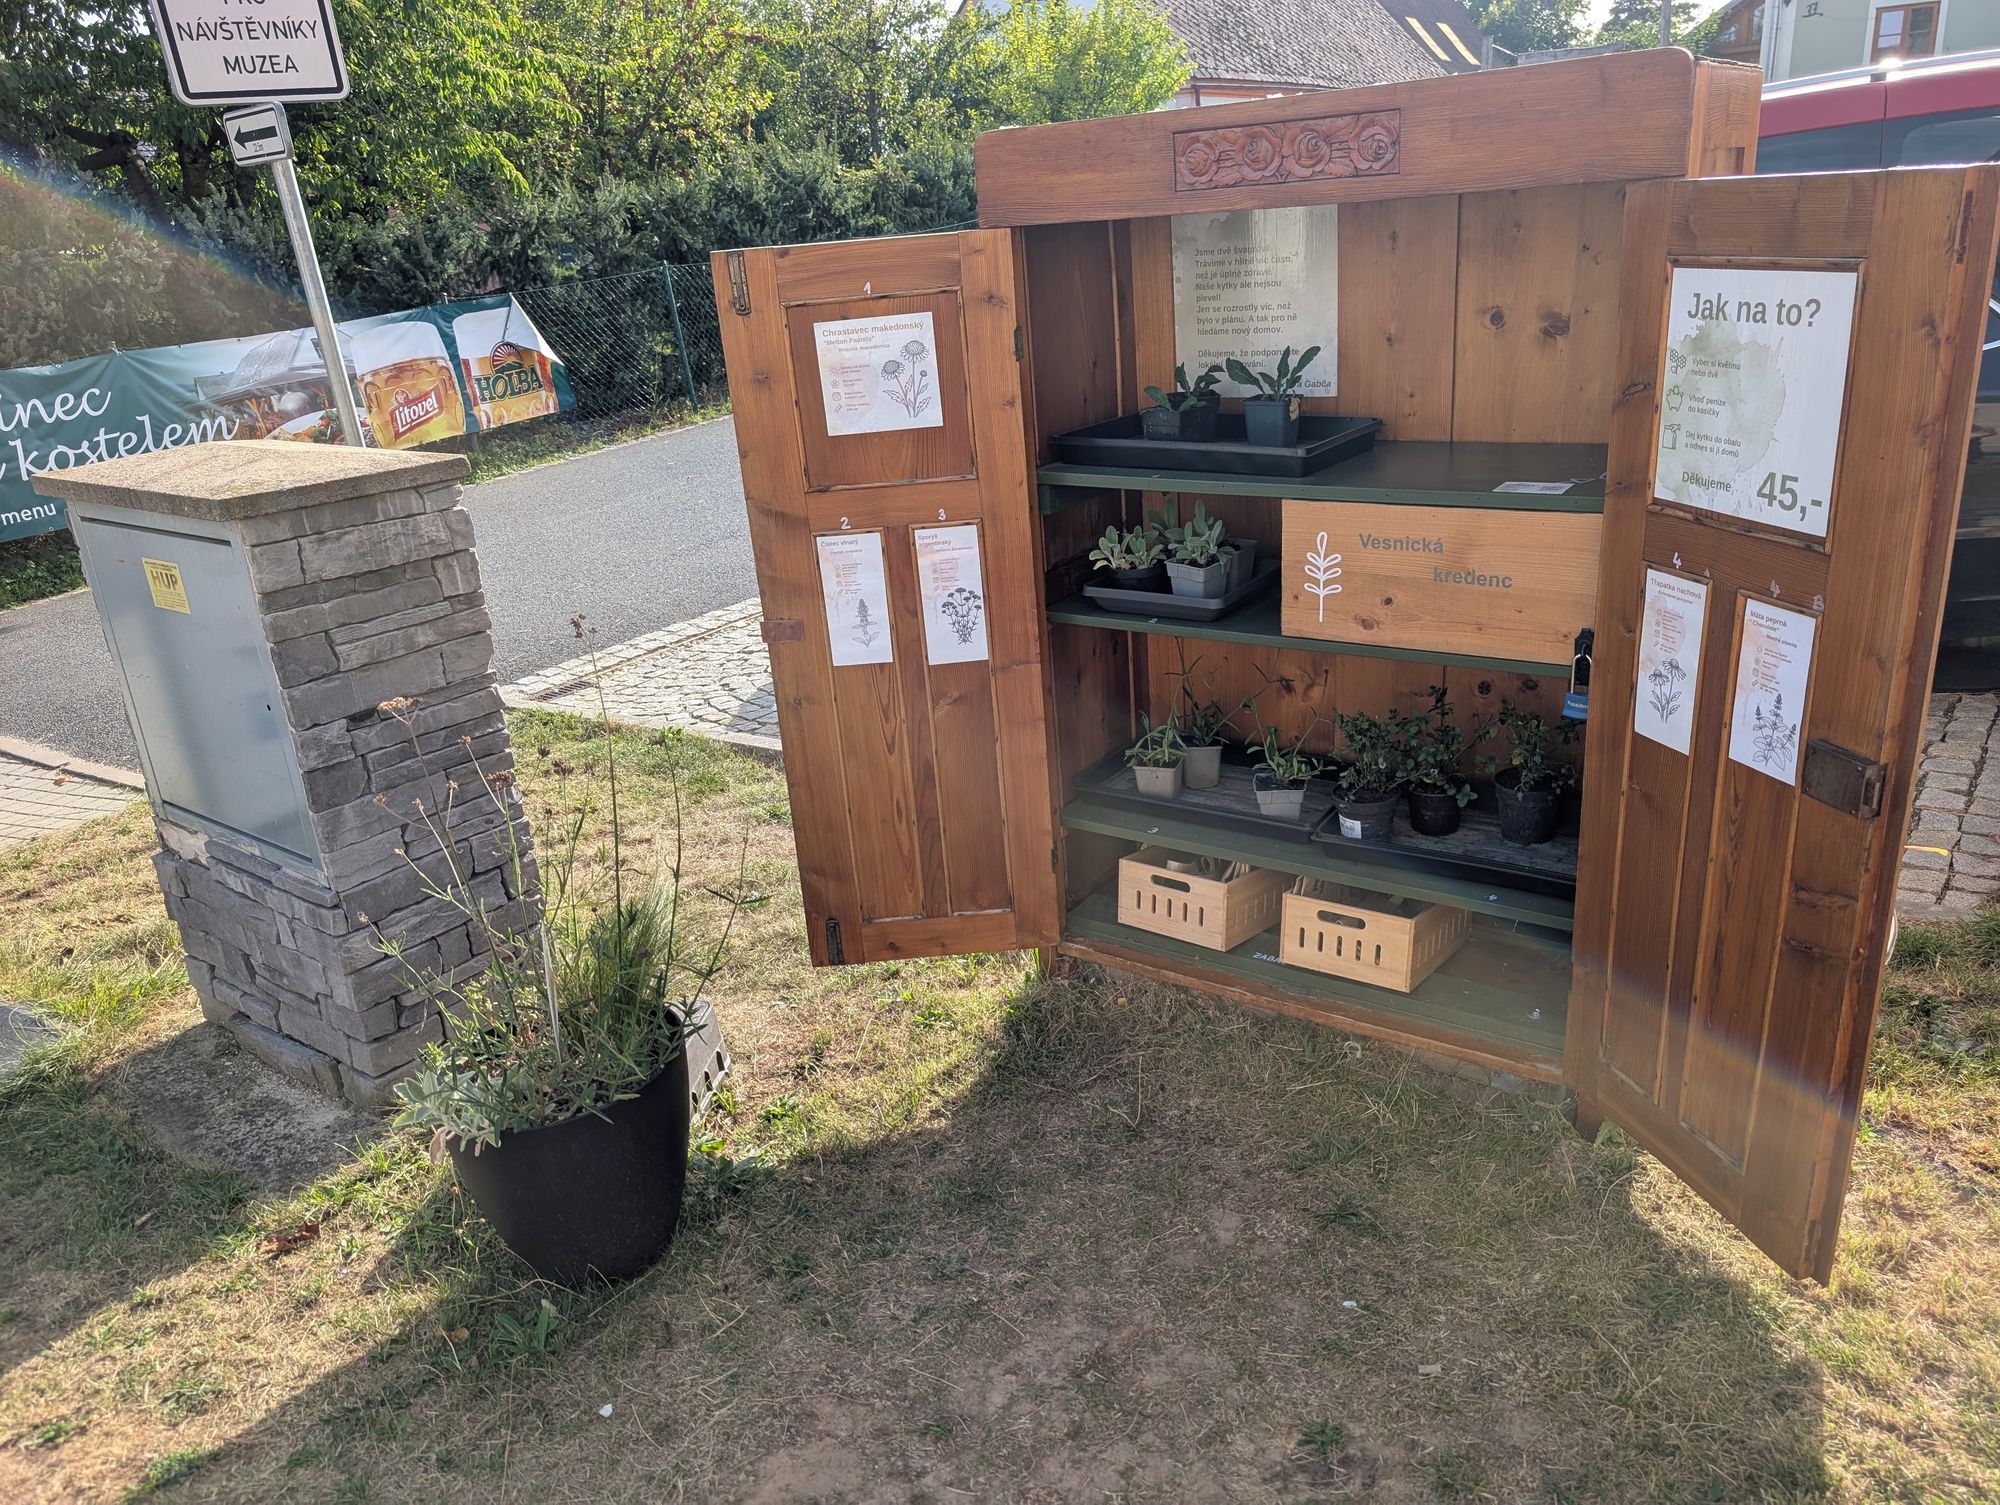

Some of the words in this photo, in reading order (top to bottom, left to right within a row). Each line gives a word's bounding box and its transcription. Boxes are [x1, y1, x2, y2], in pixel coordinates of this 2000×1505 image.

[176, 15, 317, 42] NÁVŠTĚVNÍKY
[223, 54, 299, 75] MUZEA
[1195, 248, 1215, 257] Jsme
[1217, 247, 1231, 256] dvě
[1195, 259, 1225, 269] Trávíme
[1196, 271, 1208, 280] než
[1211, 270, 1217, 280] je
[863, 281, 871, 295] 1
[1196, 281, 1214, 291] Naše
[1217, 281, 1238, 292] kytky
[1240, 281, 1251, 289] ale
[1254, 280, 1281, 290] nejsou
[1197, 305, 1210, 313] Jen
[1212, 305, 1221, 313] se
[1223, 303, 1258, 314] rozrostly
[1277, 301, 1292, 310] než
[1687, 292, 1729, 321] Jak
[1736, 300, 1767, 325] na
[1775, 298, 1822, 328] to?
[1197, 316, 1213, 326] bylo
[1222, 315, 1246, 325] plánu.
[1248, 314, 1254, 322] A
[1257, 314, 1269, 322] tak
[1271, 314, 1285, 323] pro
[1287, 312, 1297, 321] ně
[822, 326, 869, 338] Chrastavec
[871, 320, 924, 333] makedonský
[1197, 326, 1230, 336] hledáme
[1231, 326, 1251, 336] nový
[1253, 325, 1284, 334] domov.
[1198, 349, 1238, 359] Děkujeme,
[1240, 348, 1249, 357] že
[1251, 347, 1299, 358] podporute
[1692, 358, 1709, 368] Vyber
[1711, 359, 1716, 367] si
[1718, 360, 1741, 370] květinu
[1691, 369, 1706, 377] nebo
[1707, 370, 1719, 379] dvě
[474, 365, 544, 403] HOLBA
[1304, 379, 1332, 388] Gabča
[1706, 397, 1727, 408] peníze
[1688, 405, 1696, 413] do
[1697, 406, 1720, 418] kasičky
[1685, 430, 1696, 441] Dej
[1696, 431, 1713, 442] kytku
[1714, 435, 1722, 444] do
[1723, 437, 1742, 448] obalu
[9, 413, 239, 481] kostelem
[1690, 442, 1708, 452] odnes
[1709, 445, 1714, 454] si
[1721, 447, 1739, 458] domů
[1756, 471, 1823, 522] 45,-
[1, 502, 57, 526] menu
[938, 508, 946, 520] 3
[840, 516, 851, 530] 2
[1358, 532, 1444, 554] Vesnická
[1672, 551, 1682, 569] 4
[150, 569, 179, 591] HUP
[1433, 566, 1513, 589] kredenc
[1765, 615, 1787, 628] peprná
